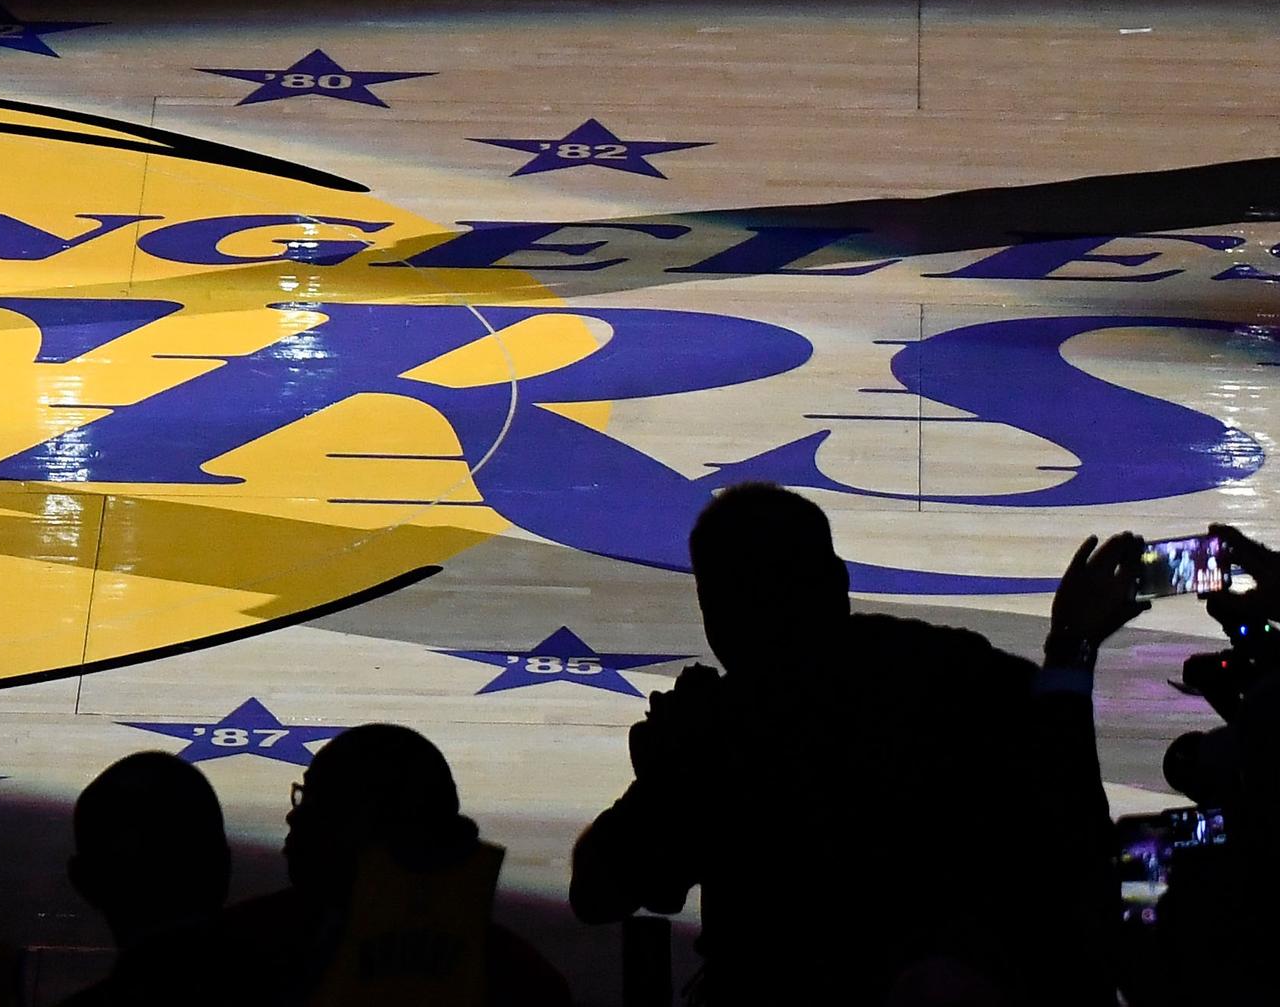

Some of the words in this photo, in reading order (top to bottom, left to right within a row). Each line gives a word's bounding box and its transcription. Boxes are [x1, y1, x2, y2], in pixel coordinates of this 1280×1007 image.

[264, 72, 352, 90] '80
[539, 143, 629, 161] '82
[506, 654, 602, 677] '85
[192, 726, 290, 749] '87
